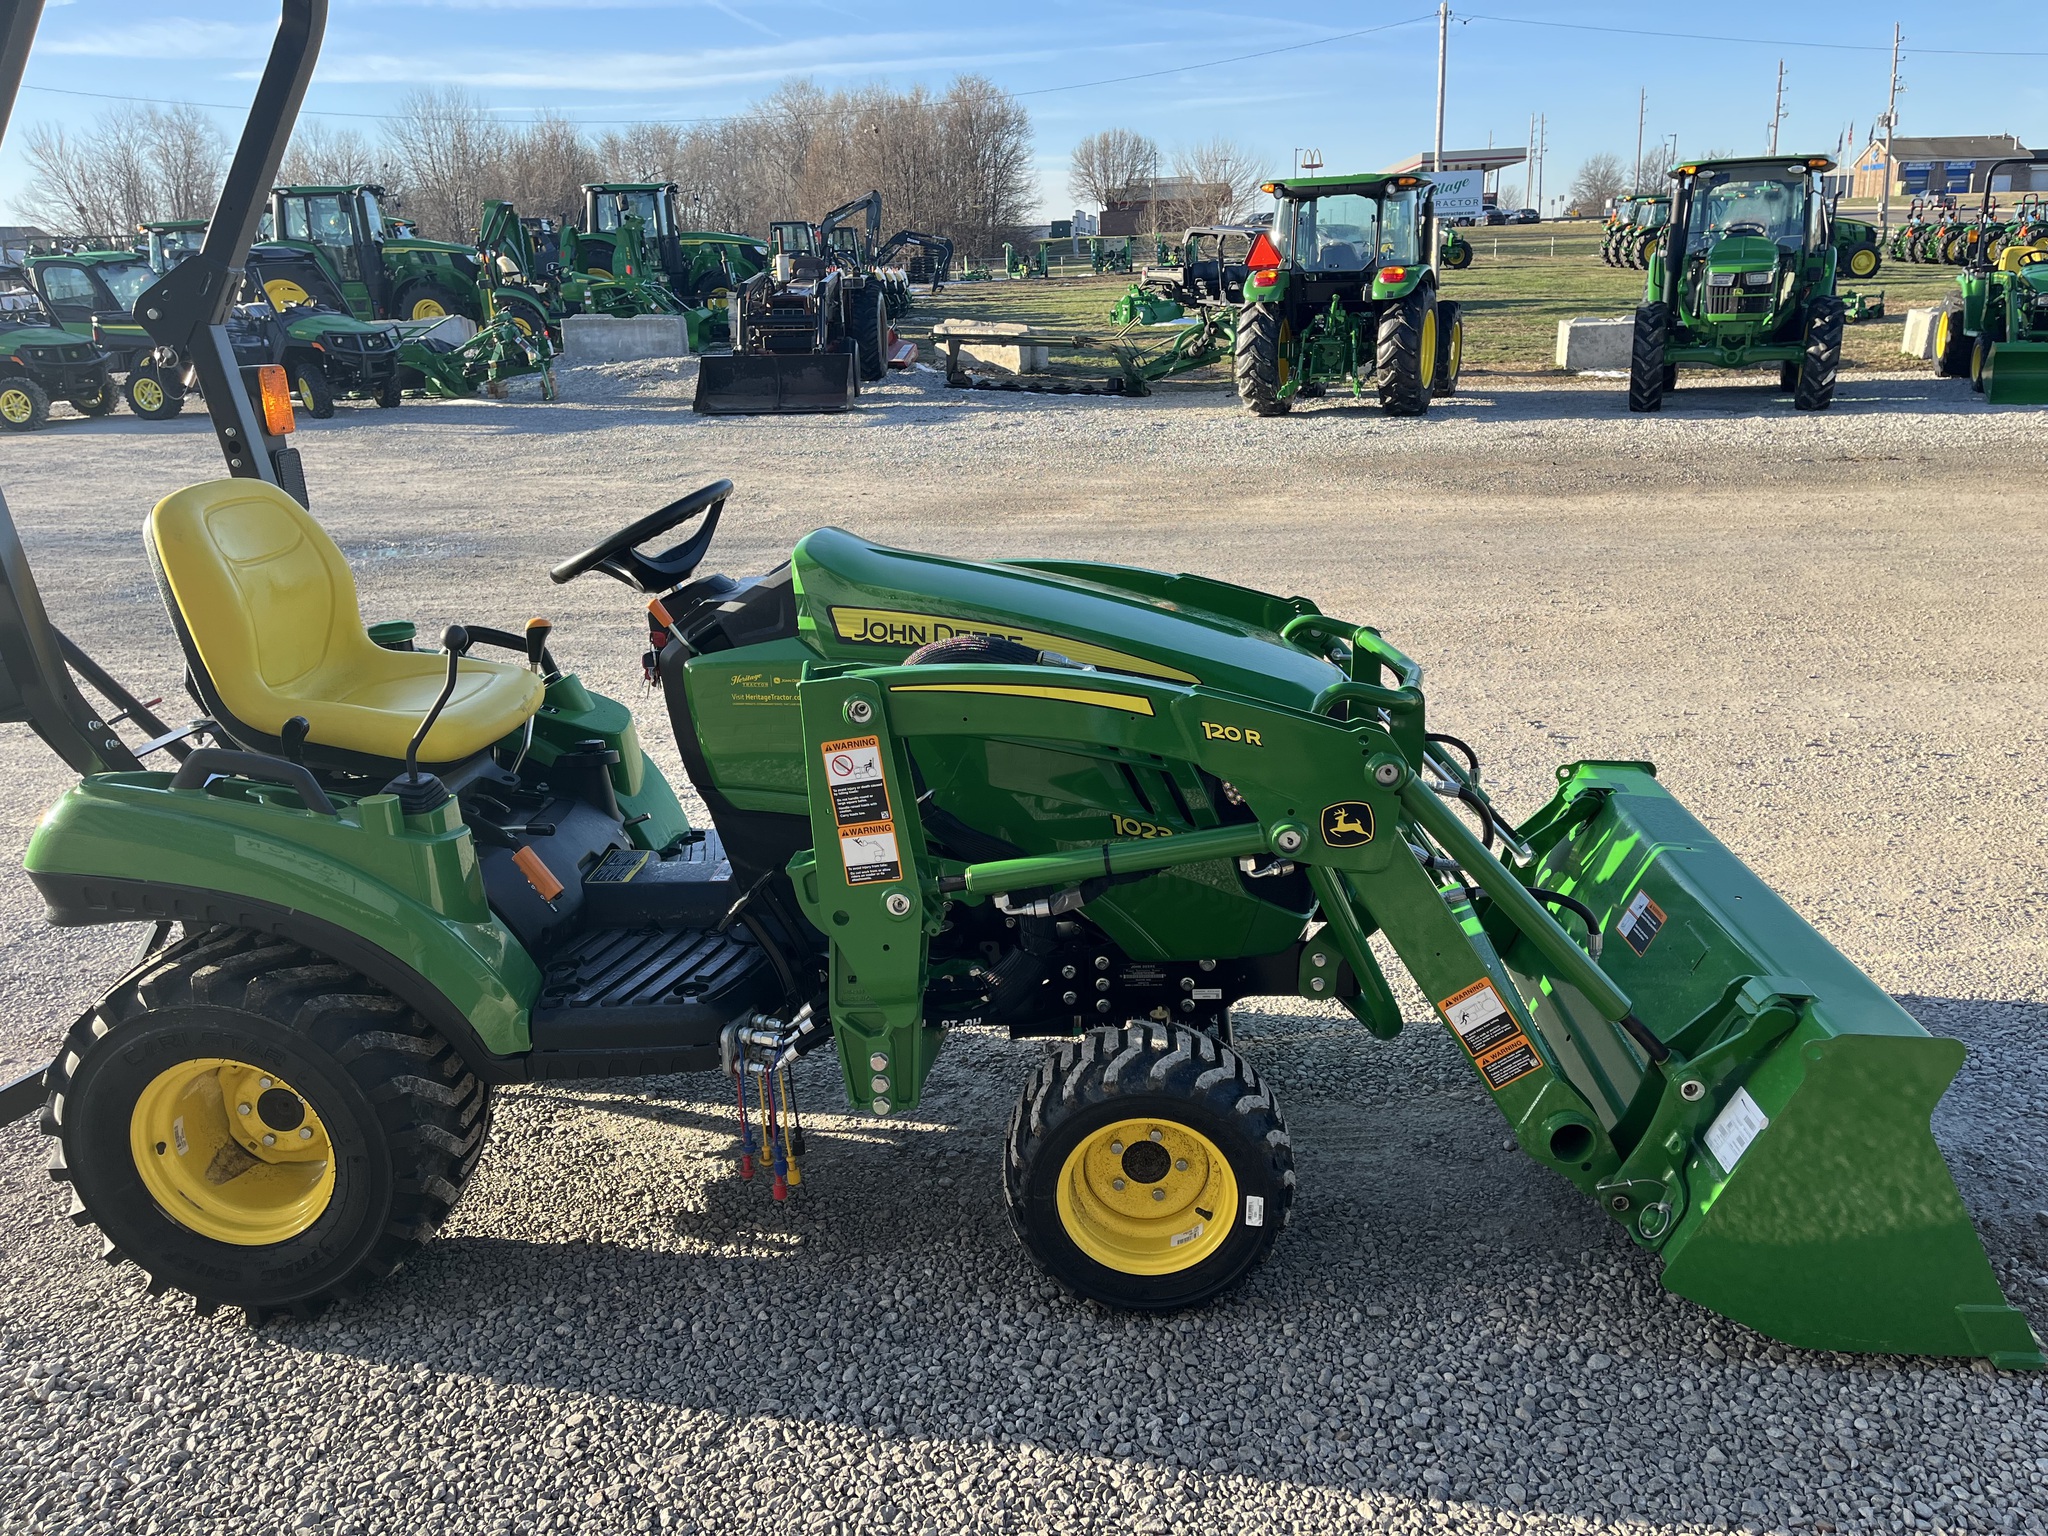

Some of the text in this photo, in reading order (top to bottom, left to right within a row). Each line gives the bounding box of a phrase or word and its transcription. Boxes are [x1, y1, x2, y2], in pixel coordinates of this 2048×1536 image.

[1418, 178, 1470, 198] itage
[1436, 199, 1479, 207] RACTOR
[854, 618, 926, 642] JOHN
[730, 674, 762, 686] Heritage
[746, 694, 800, 702] HeritageTractor.co
[1201, 721, 1262, 746] 120 R
[832, 738, 875, 750] WARNING
[849, 824, 892, 835] WARNING
[1112, 814, 1173, 838] 1023
[1452, 982, 1484, 1002] WARNING
[1490, 1041, 1522, 1059] WARNING
